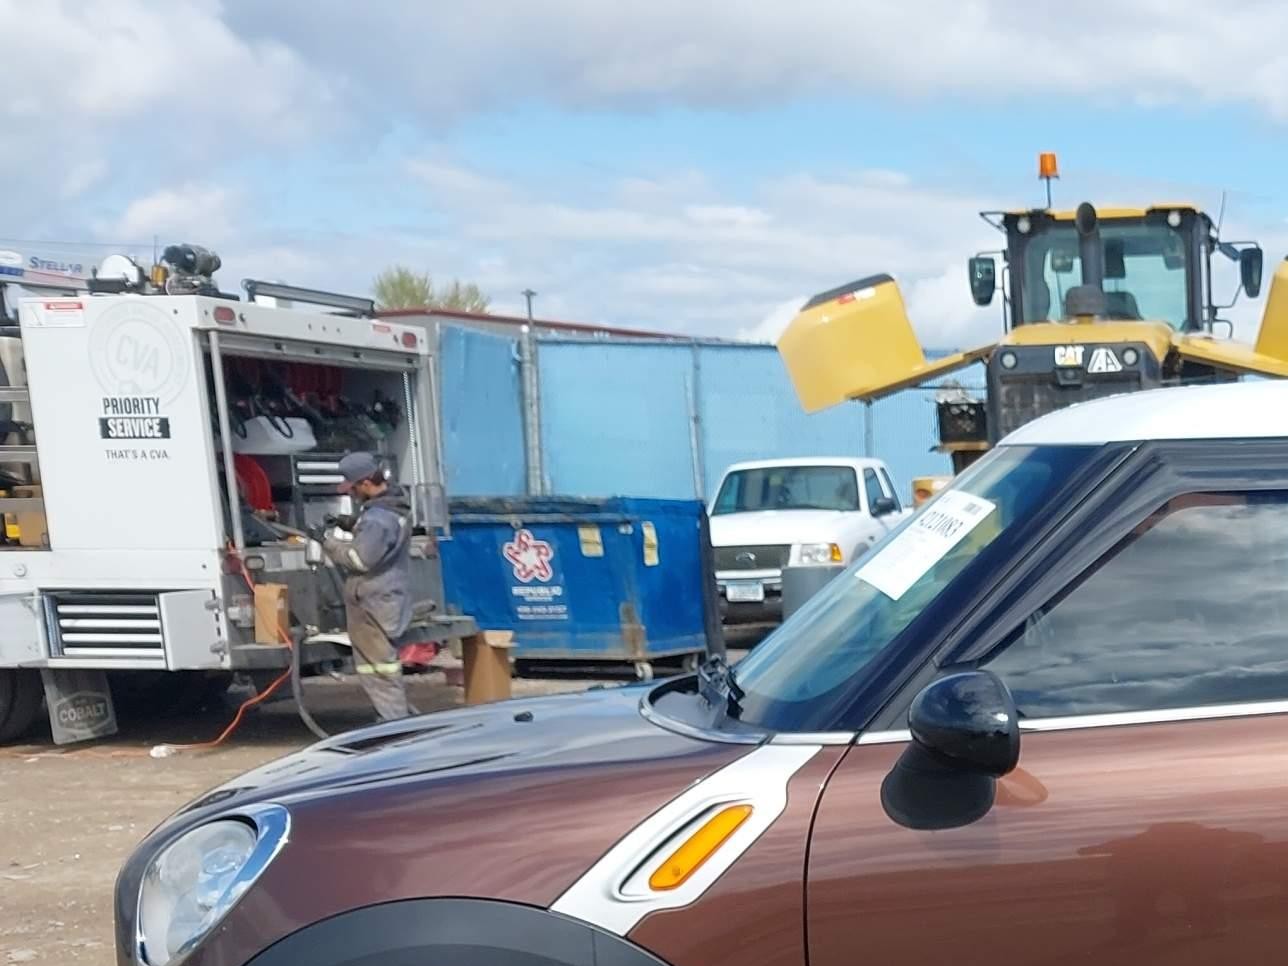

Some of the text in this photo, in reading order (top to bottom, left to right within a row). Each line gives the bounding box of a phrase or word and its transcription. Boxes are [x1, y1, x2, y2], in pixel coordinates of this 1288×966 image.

[1055, 345, 1084, 366] CAT
[102, 397, 159, 414] PRIORITY
[107, 418, 162, 438] SERVICE
[105, 449, 137, 459] THAT'S
[141, 449, 148, 459] A
[60, 703, 105, 722] COBALT
